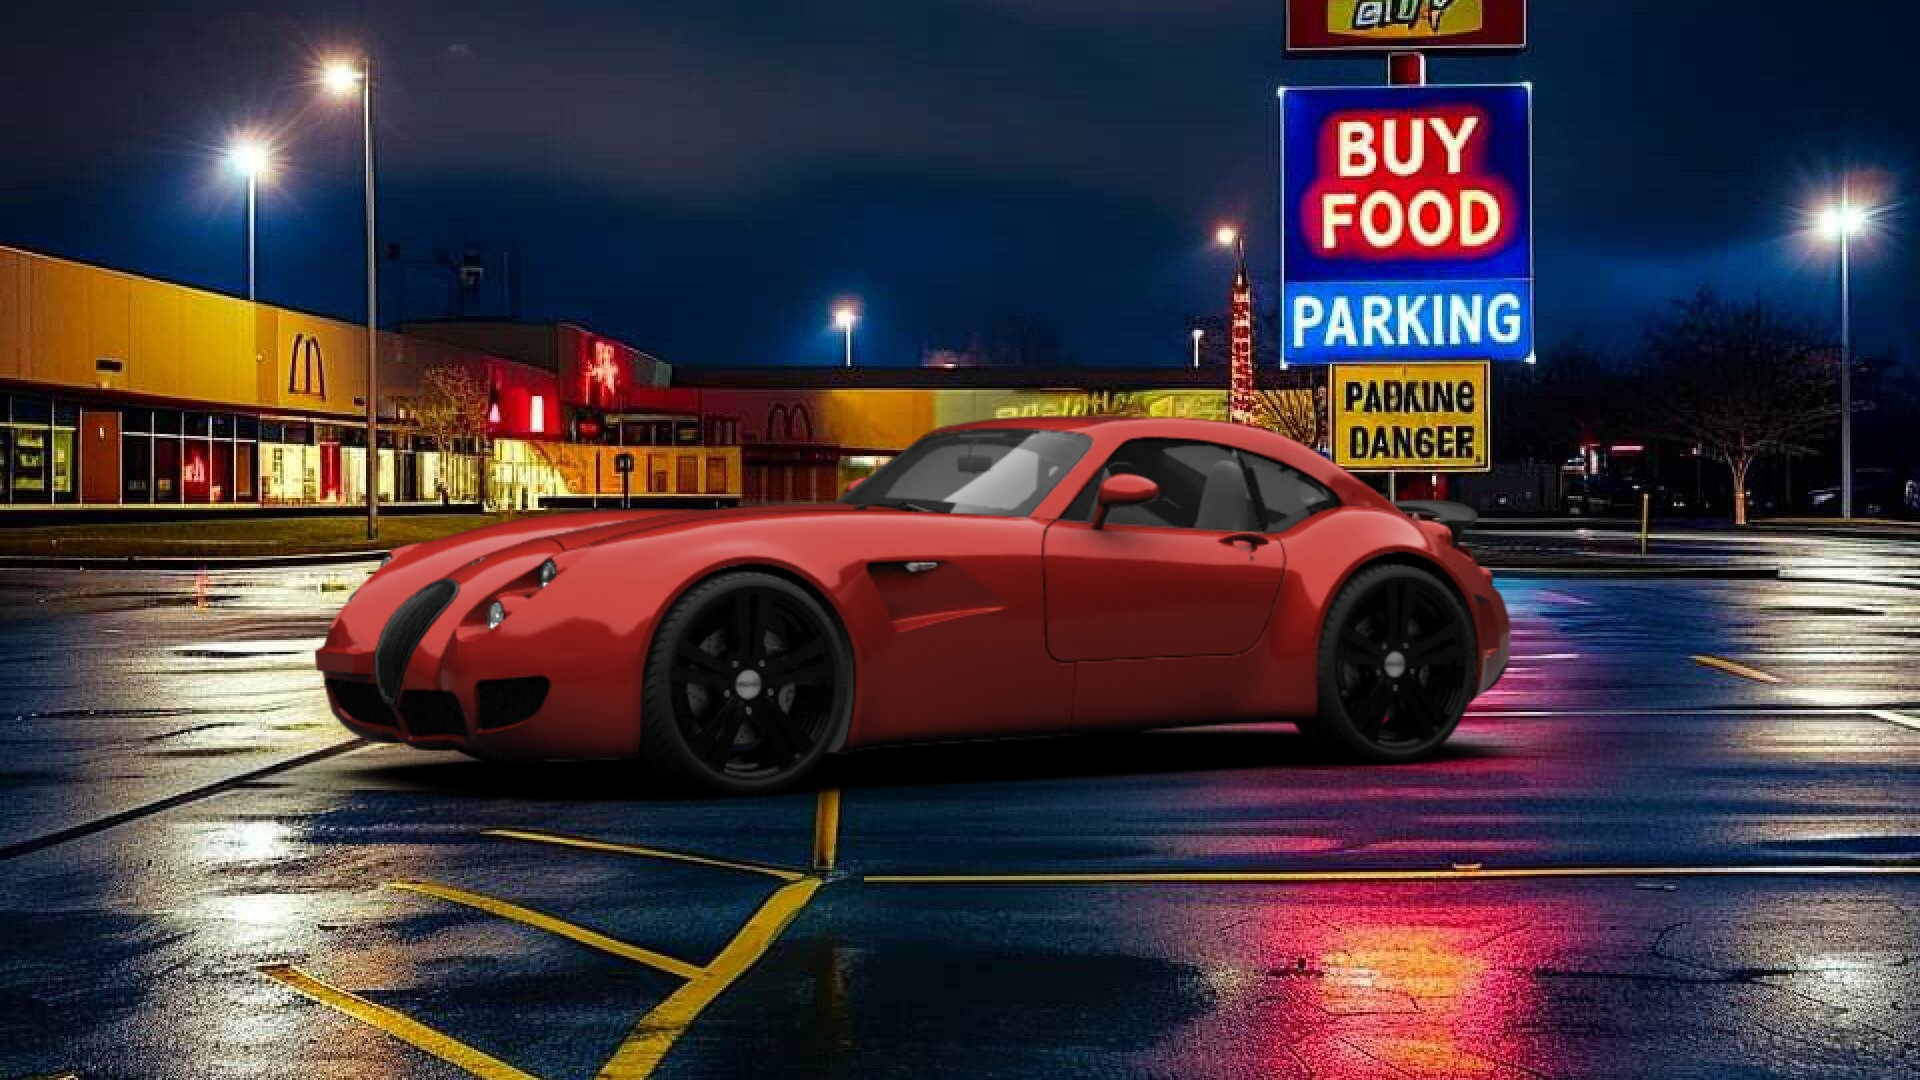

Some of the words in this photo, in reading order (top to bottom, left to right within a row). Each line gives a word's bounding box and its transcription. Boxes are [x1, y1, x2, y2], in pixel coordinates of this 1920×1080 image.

[1337, 117, 1479, 177] BUY
[1322, 189, 1501, 249] FOOD
[1293, 293, 1521, 348] PARKING
